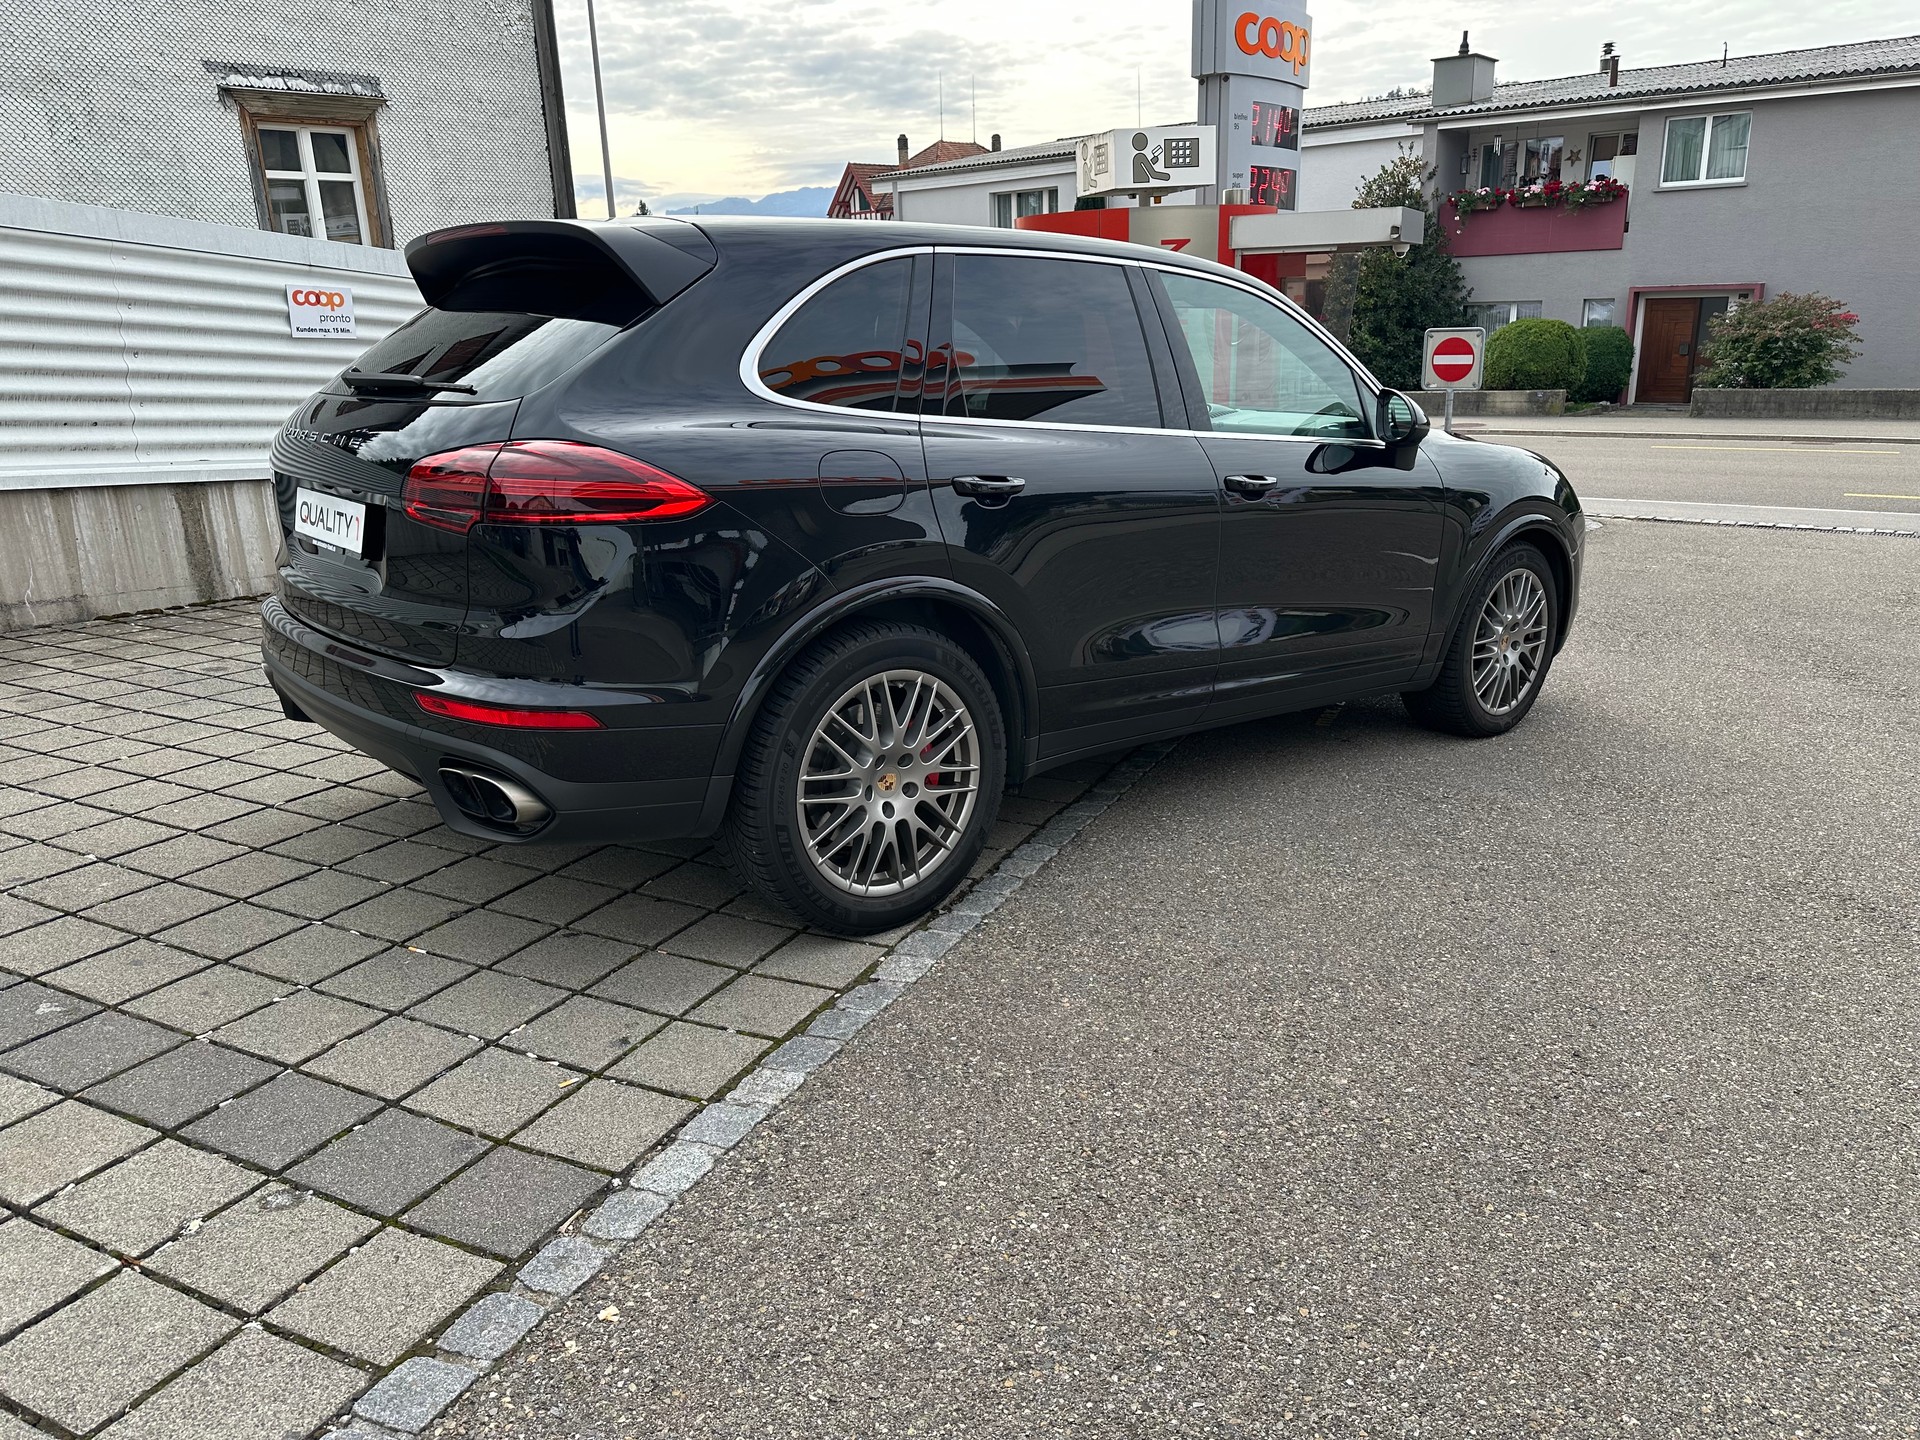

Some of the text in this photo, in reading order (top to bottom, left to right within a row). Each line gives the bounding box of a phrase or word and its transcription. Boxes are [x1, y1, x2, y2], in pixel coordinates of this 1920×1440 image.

[1235, 12, 1309, 76] coop
[1233, 112, 1248, 121] bleifrei
[1232, 172, 1244, 180] super
[1231, 181, 1241, 189] plus
[292, 289, 345, 312] coop
[319, 314, 351, 324] pronto
[285, 427, 362, 449] PORSCHE
[777, 830, 833, 912] MICHELIN
